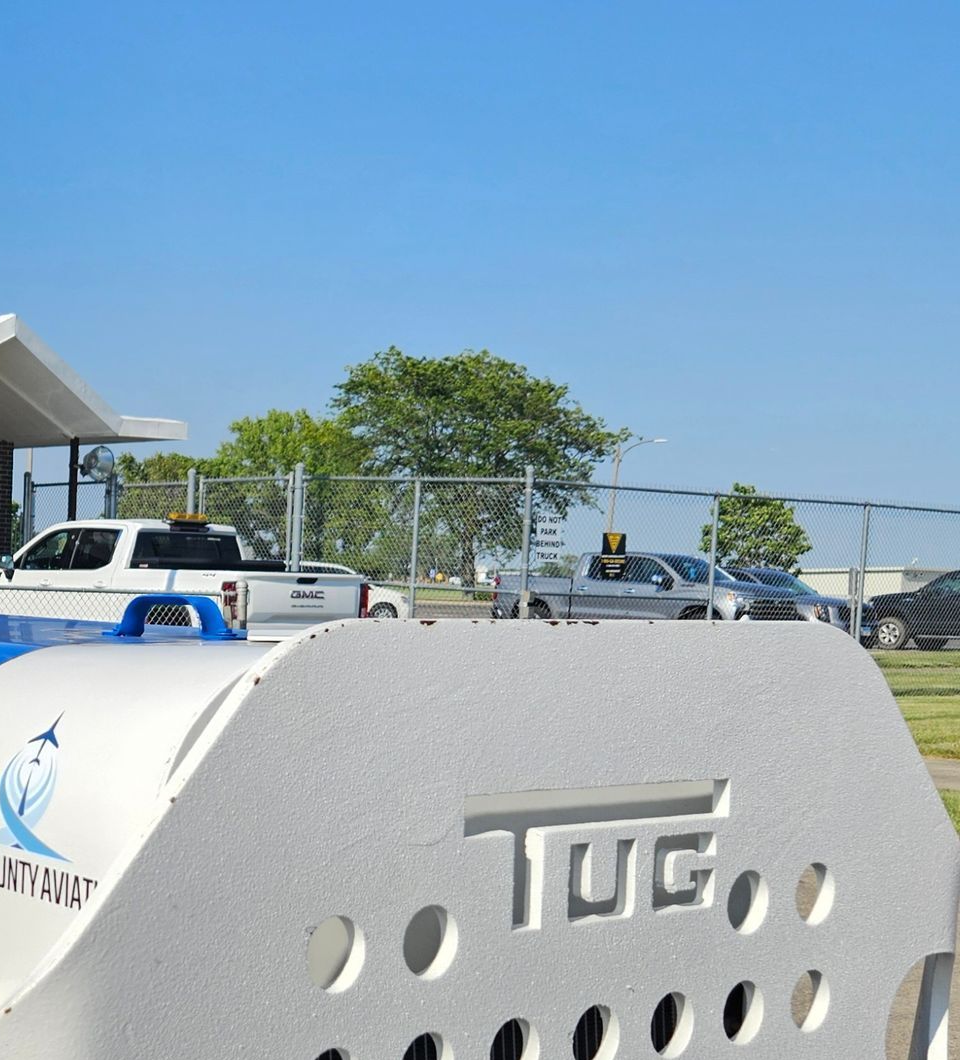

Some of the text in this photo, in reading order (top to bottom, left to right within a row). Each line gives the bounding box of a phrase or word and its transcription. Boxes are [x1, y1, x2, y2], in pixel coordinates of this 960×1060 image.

[537, 515, 561, 524] DO NOT
[540, 528, 557, 536] PARK
[536, 540, 560, 548] BEHIND
[536, 552, 558, 560] TRUCK
[290, 590, 325, 600] GMC
[463, 778, 731, 933] TUG
[40, 866, 98, 911] AVIAT
